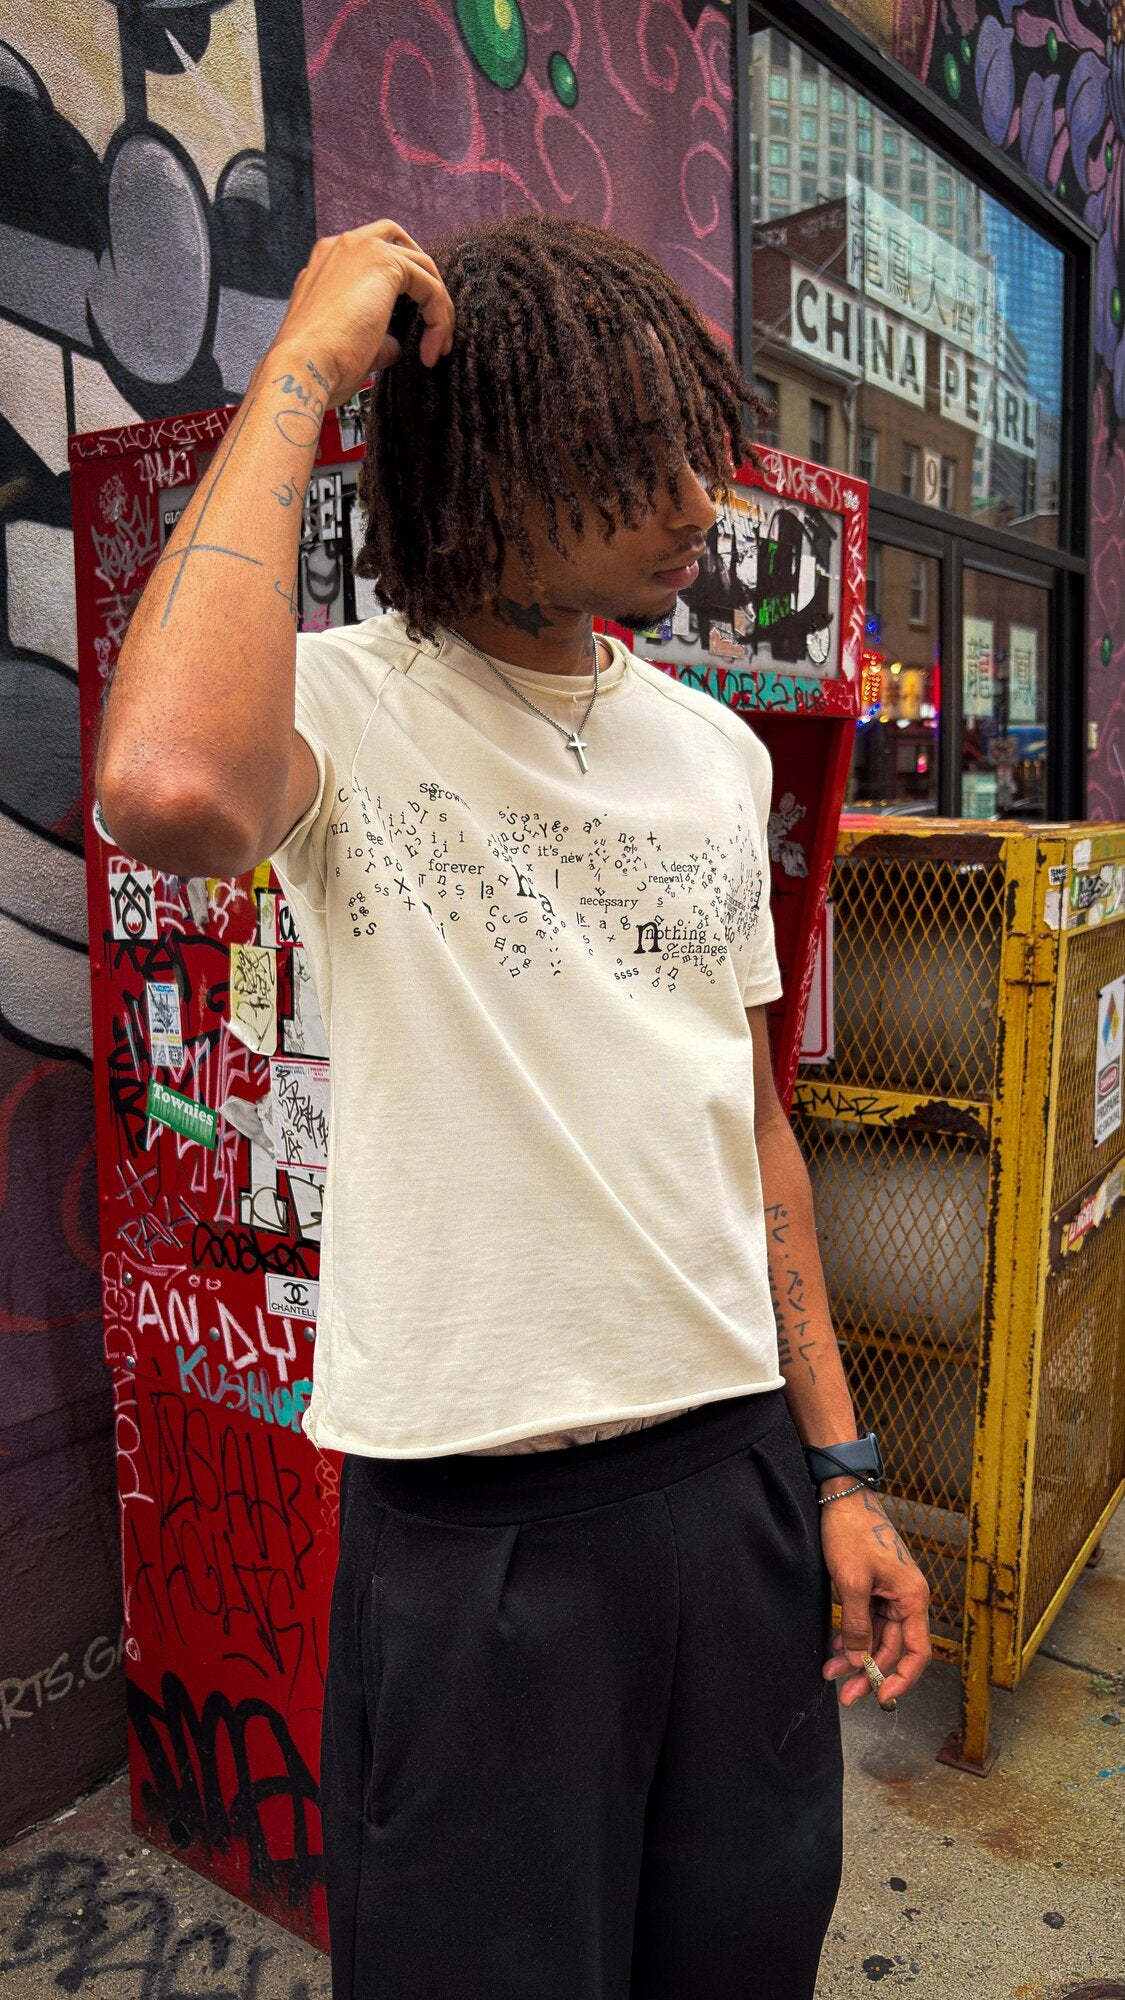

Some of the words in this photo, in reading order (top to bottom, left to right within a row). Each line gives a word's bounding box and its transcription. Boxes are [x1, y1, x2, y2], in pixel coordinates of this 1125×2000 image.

[796, 279, 920, 396] CHINA
[944, 356, 1036, 449] PEARL
[927, 459, 938, 501] 9
[537, 845, 559, 857] it's
[560, 854, 584, 864] new
[428, 859, 485, 875] forever
[670, 861, 701, 876] decay
[648, 873, 683, 884] renewal
[579, 896, 639, 910] necessary
[644, 925, 707, 944] nothing
[680, 942, 728, 957] changes
[153, 1083, 215, 1127] Townies
